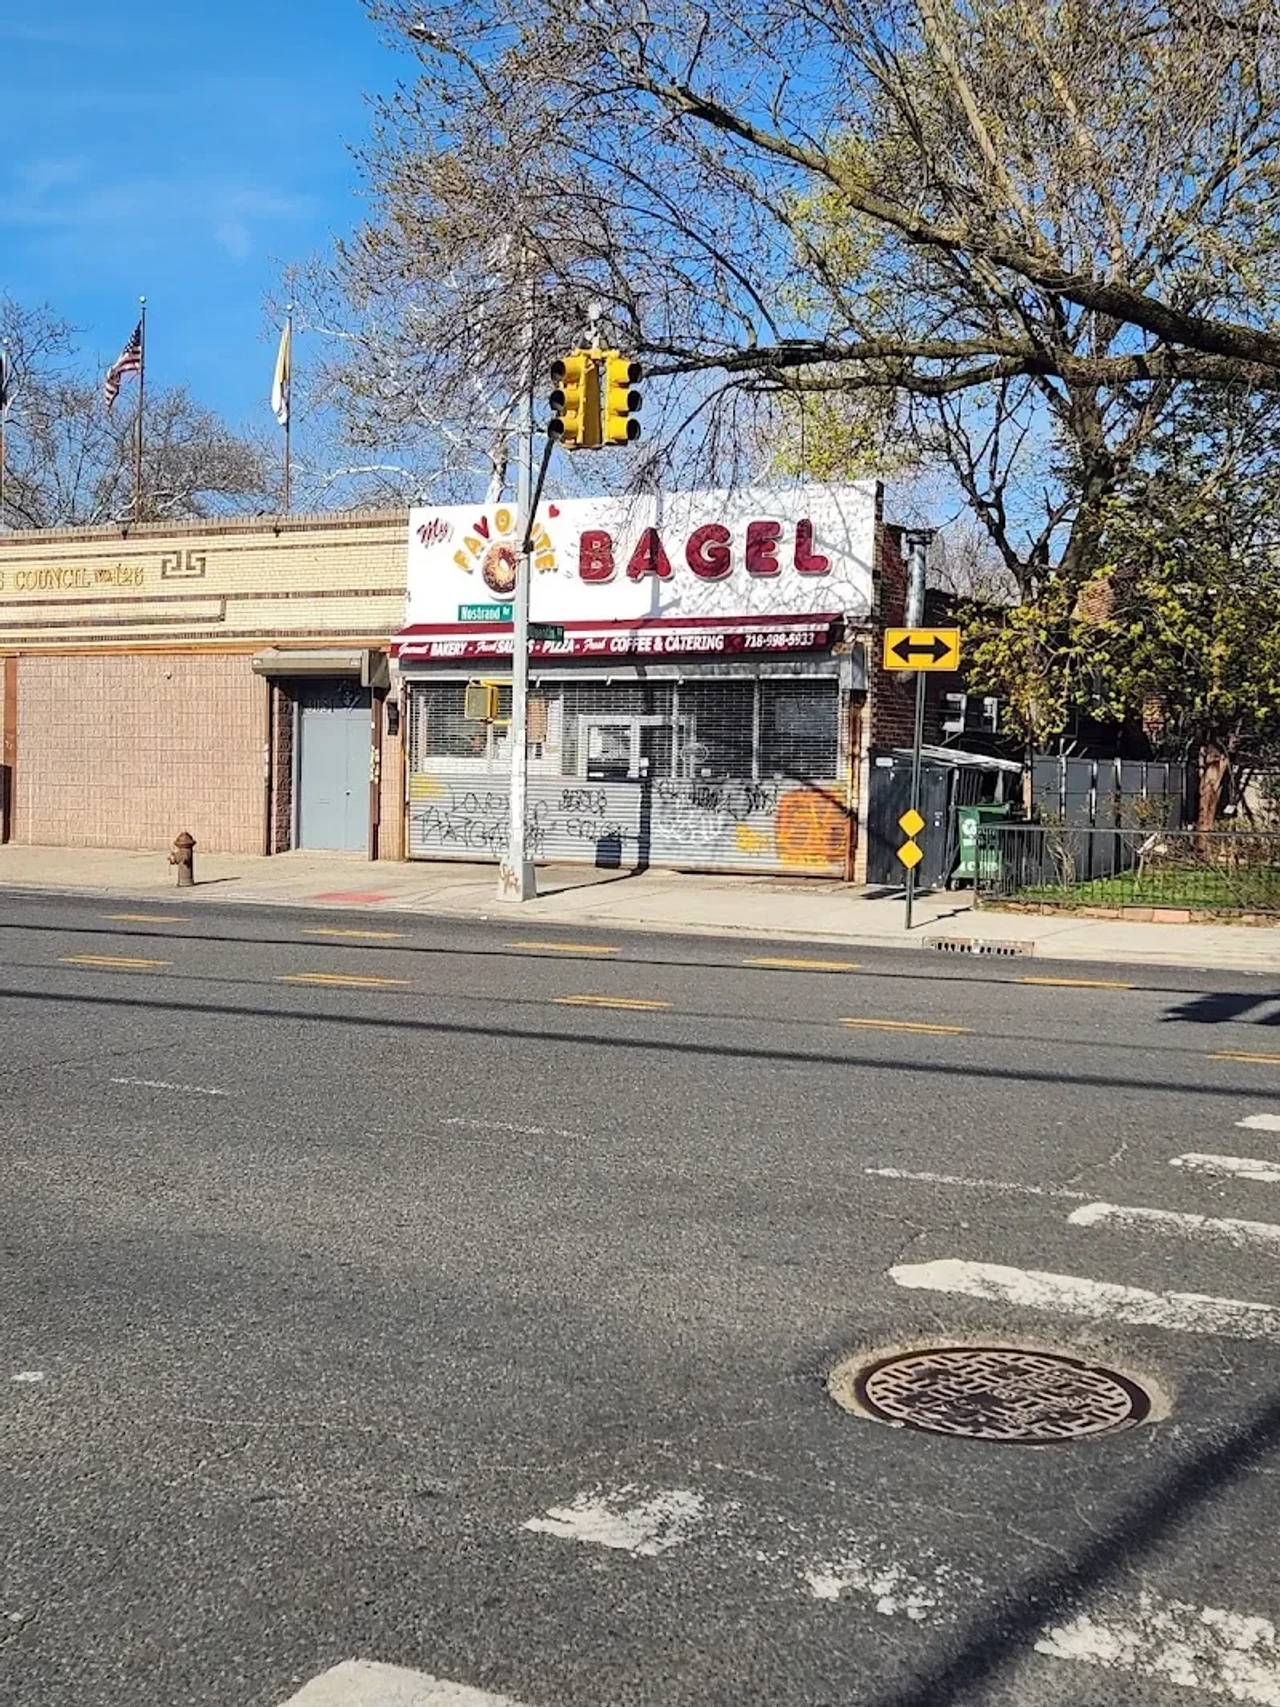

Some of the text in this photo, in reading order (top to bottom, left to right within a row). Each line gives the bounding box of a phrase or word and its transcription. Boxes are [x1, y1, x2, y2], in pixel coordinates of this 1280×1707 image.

[416, 517, 451, 544] My
[453, 508, 557, 570] FAVOITE
[579, 518, 832, 582] BAGEL
[14, 568, 91, 591] COUNCIL
[461, 606, 501, 620] Nostrand
[430, 641, 468, 656] BAKERY
[496, 639, 535, 654] SALS
[541, 638, 575, 653] PIZZA
[610, 636, 652, 653] COFFEE
[653, 636, 663, 651] &
[665, 635, 724, 652] CATERING
[744, 632, 815, 648] 718-998-5933
